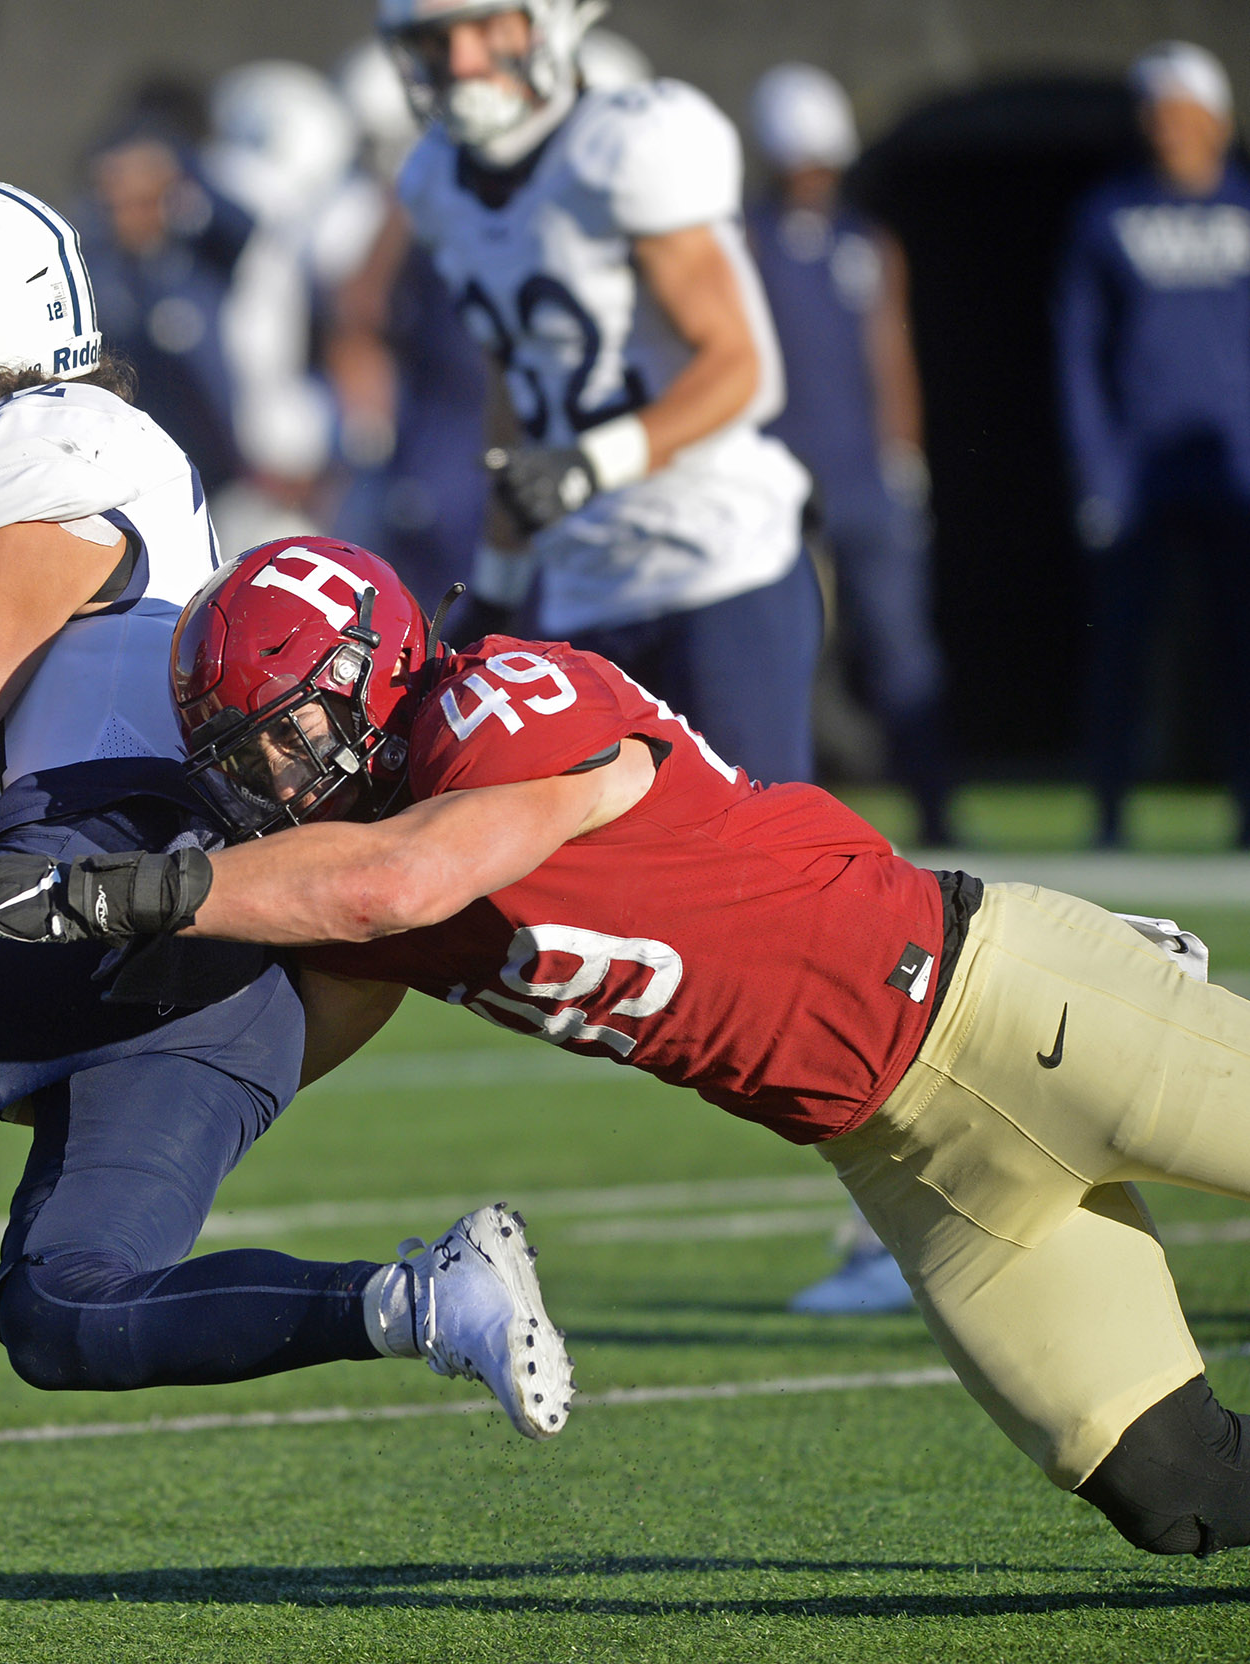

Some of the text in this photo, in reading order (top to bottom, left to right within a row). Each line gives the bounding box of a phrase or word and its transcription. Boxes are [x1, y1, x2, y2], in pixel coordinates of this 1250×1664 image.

[46, 301, 64, 321] 12
[250, 546, 380, 632] H
[439, 651, 577, 742] 49
[447, 923, 684, 1058] 49
[900, 964, 918, 975] L
